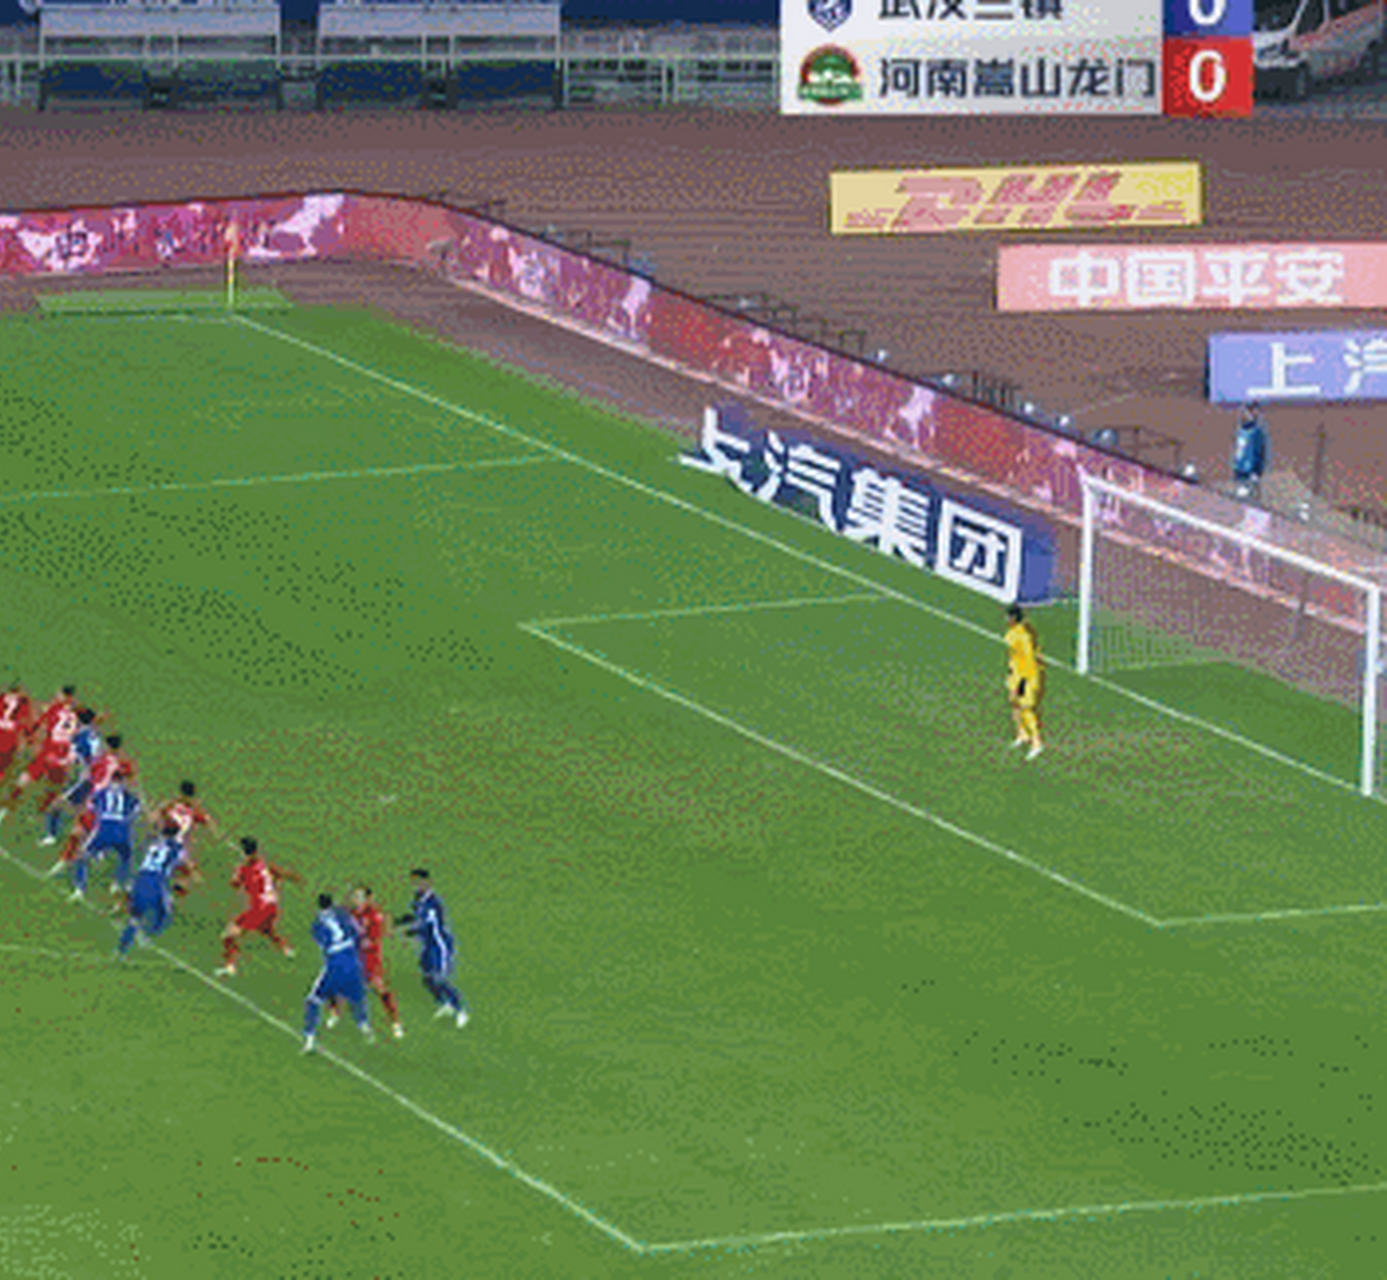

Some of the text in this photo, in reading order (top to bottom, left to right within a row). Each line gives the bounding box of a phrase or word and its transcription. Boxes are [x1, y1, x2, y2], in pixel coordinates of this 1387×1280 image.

[893, 173, 1137, 232] DHL
[1048, 249, 1345, 308] 中国平安
[676, 405, 1023, 605] 上汽集团
